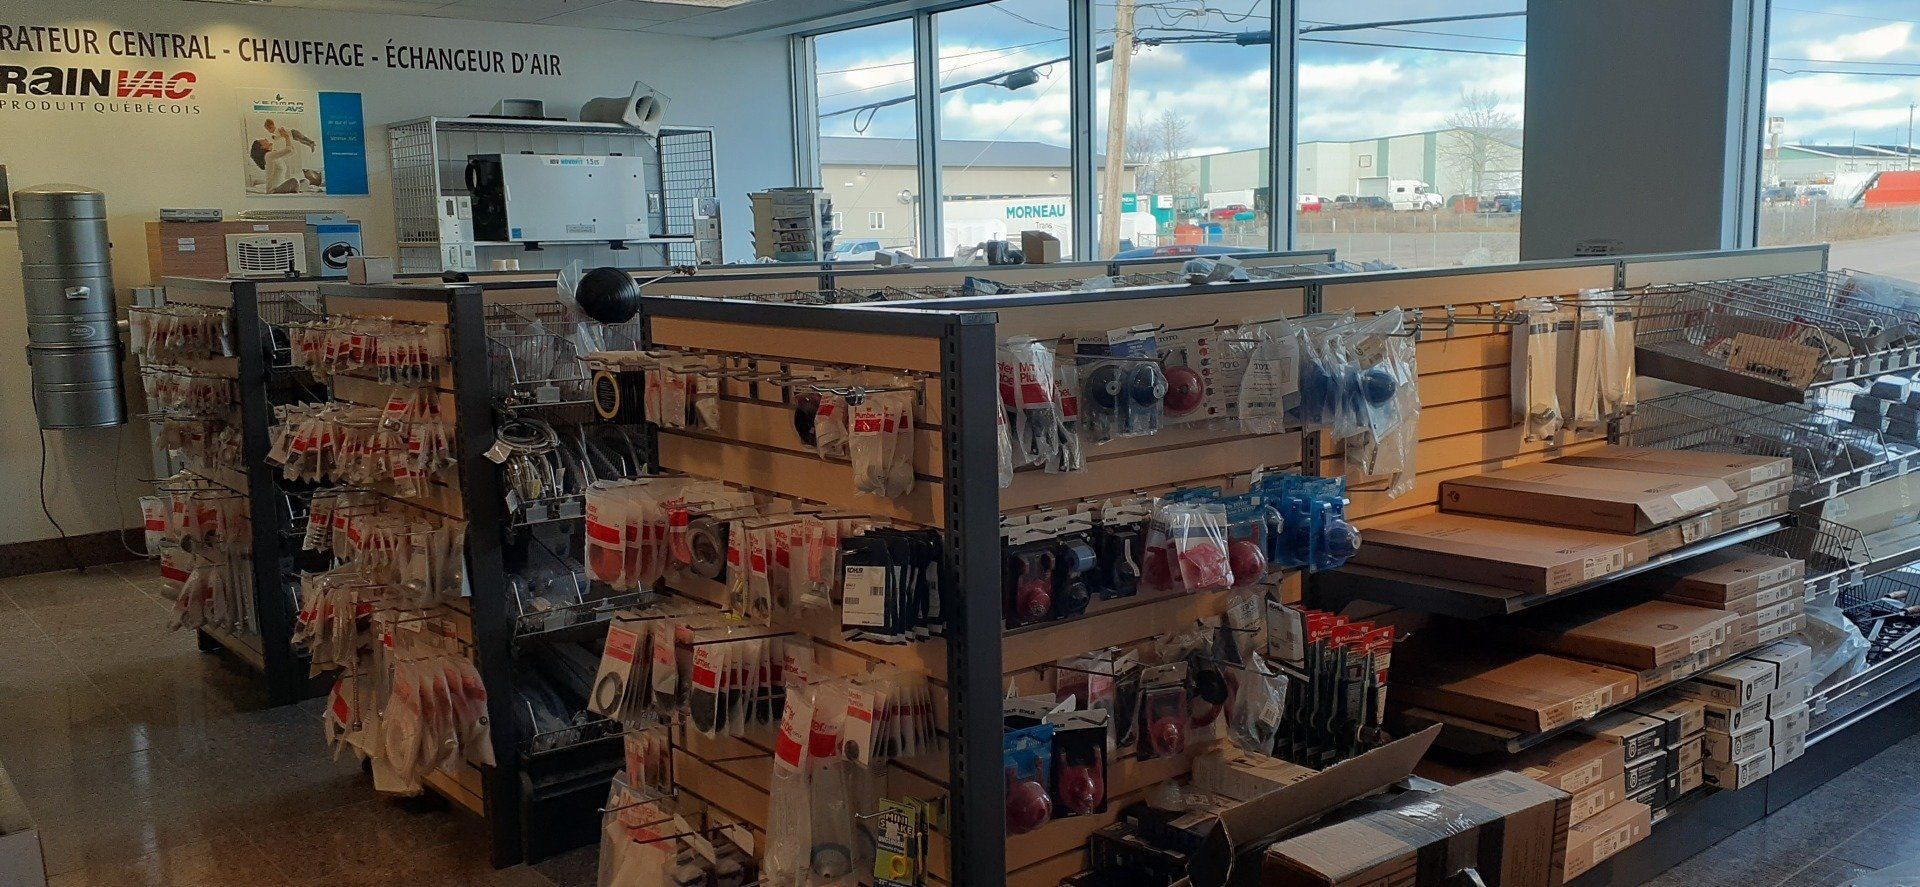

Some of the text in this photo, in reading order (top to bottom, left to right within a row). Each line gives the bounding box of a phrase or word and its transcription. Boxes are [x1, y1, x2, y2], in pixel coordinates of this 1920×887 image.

[109, 31, 216, 59] CENTRAL
[238, 38, 364, 66] CHAUFFAGE
[386, 38, 505, 73] ÉCHANGEUR
[94, 100, 200, 114] QUÉBÉCOIS
[1006, 204, 1066, 218] MORNEAU
[1035, 221, 1053, 229] Trans
